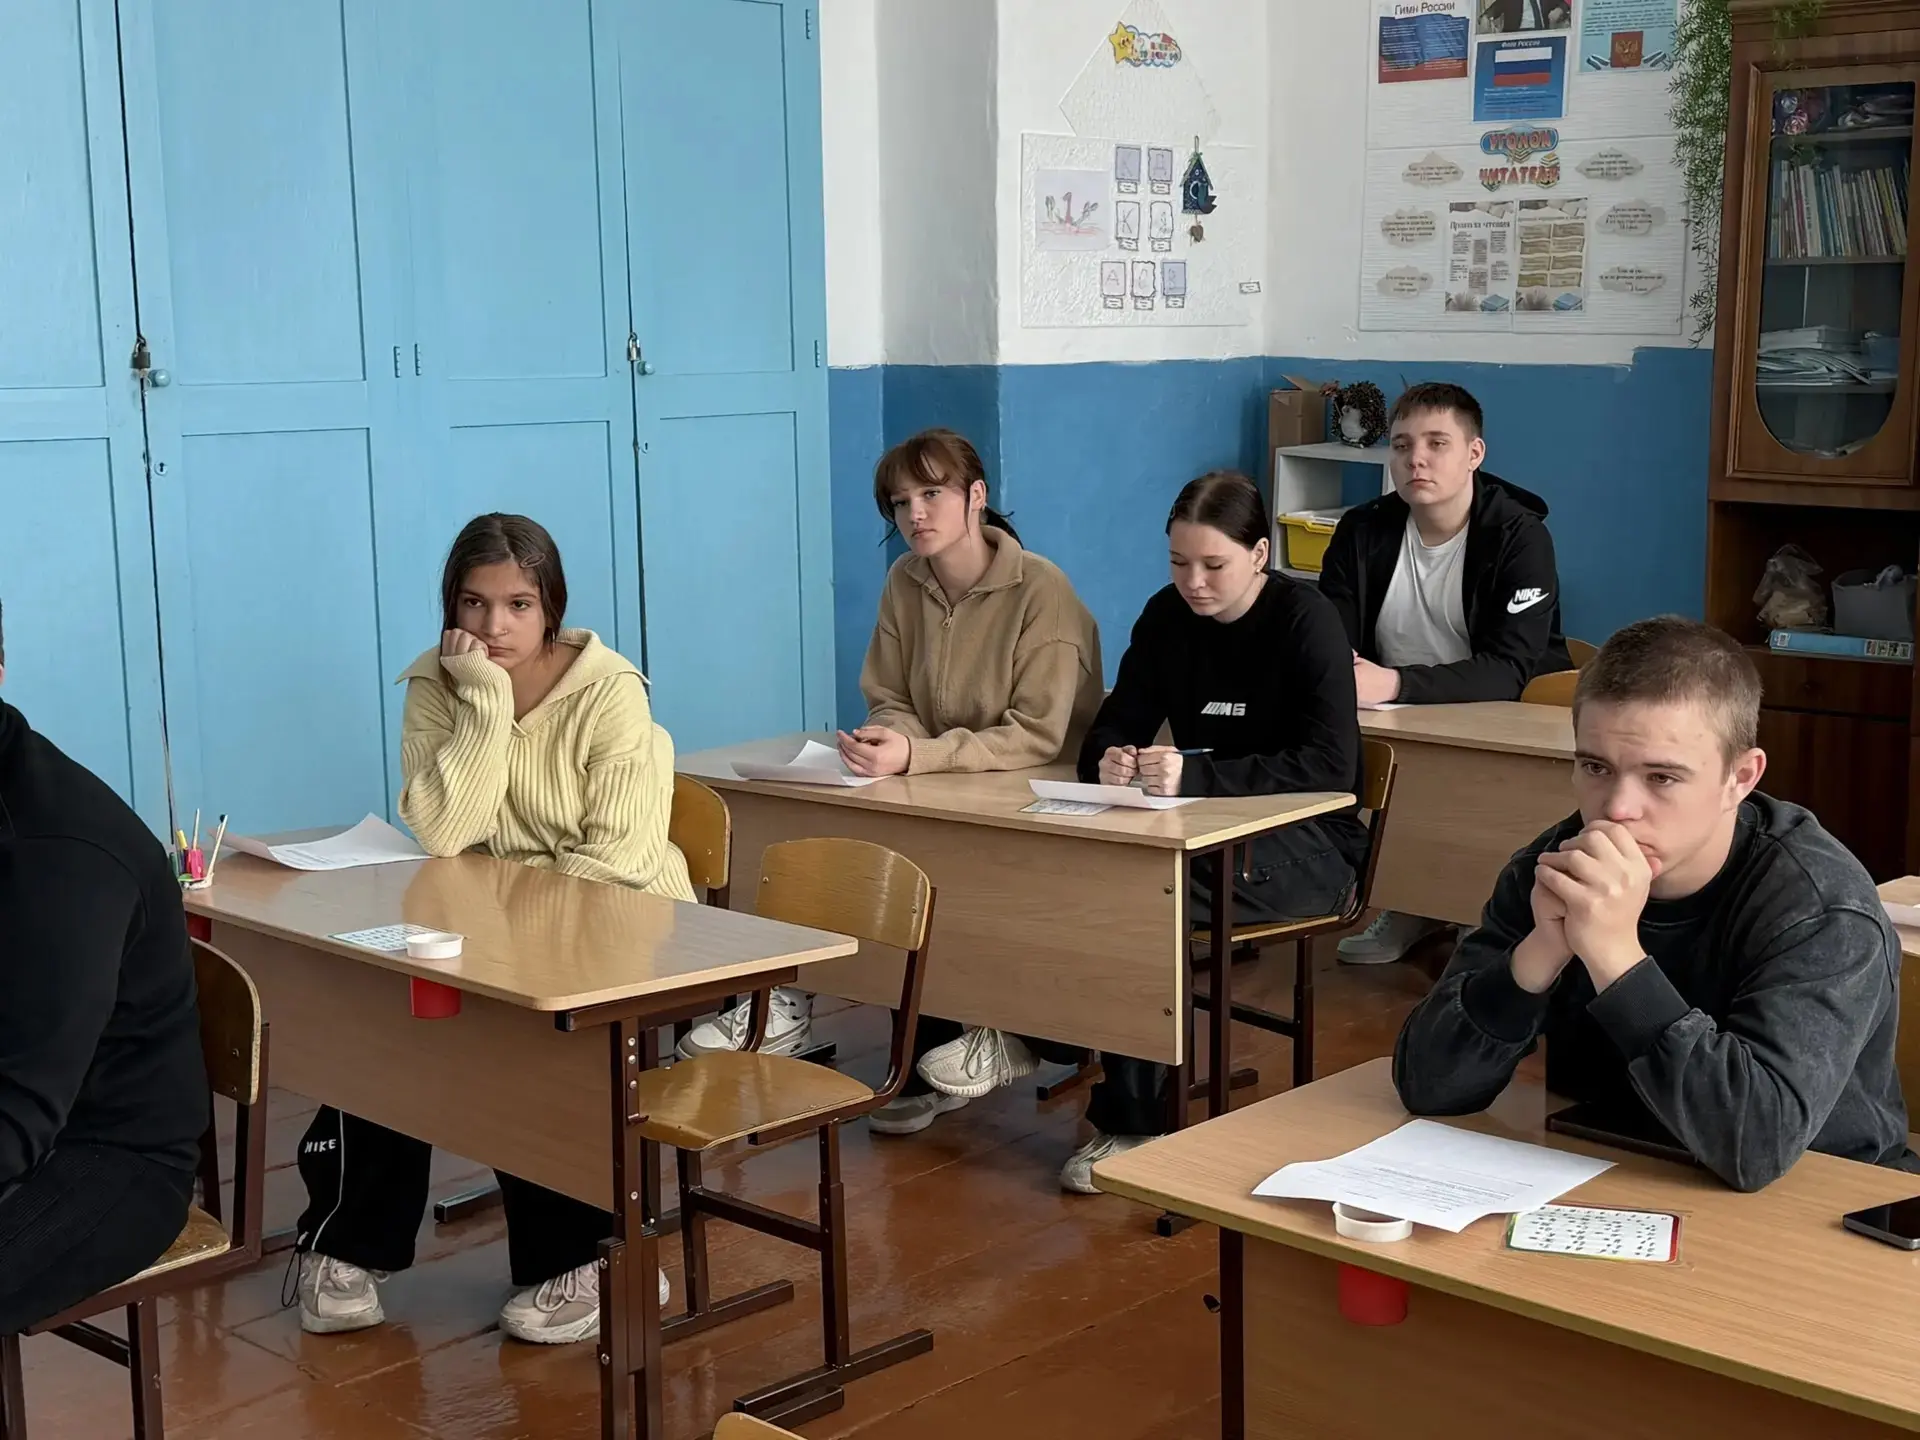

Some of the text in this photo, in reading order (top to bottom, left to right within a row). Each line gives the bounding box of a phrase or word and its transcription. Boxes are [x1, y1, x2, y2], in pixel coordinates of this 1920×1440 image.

[1394, 2, 1456, 16] Гимн России
[1514, 587, 1542, 602] NIKE
[304, 1138, 337, 1154] NIKE
